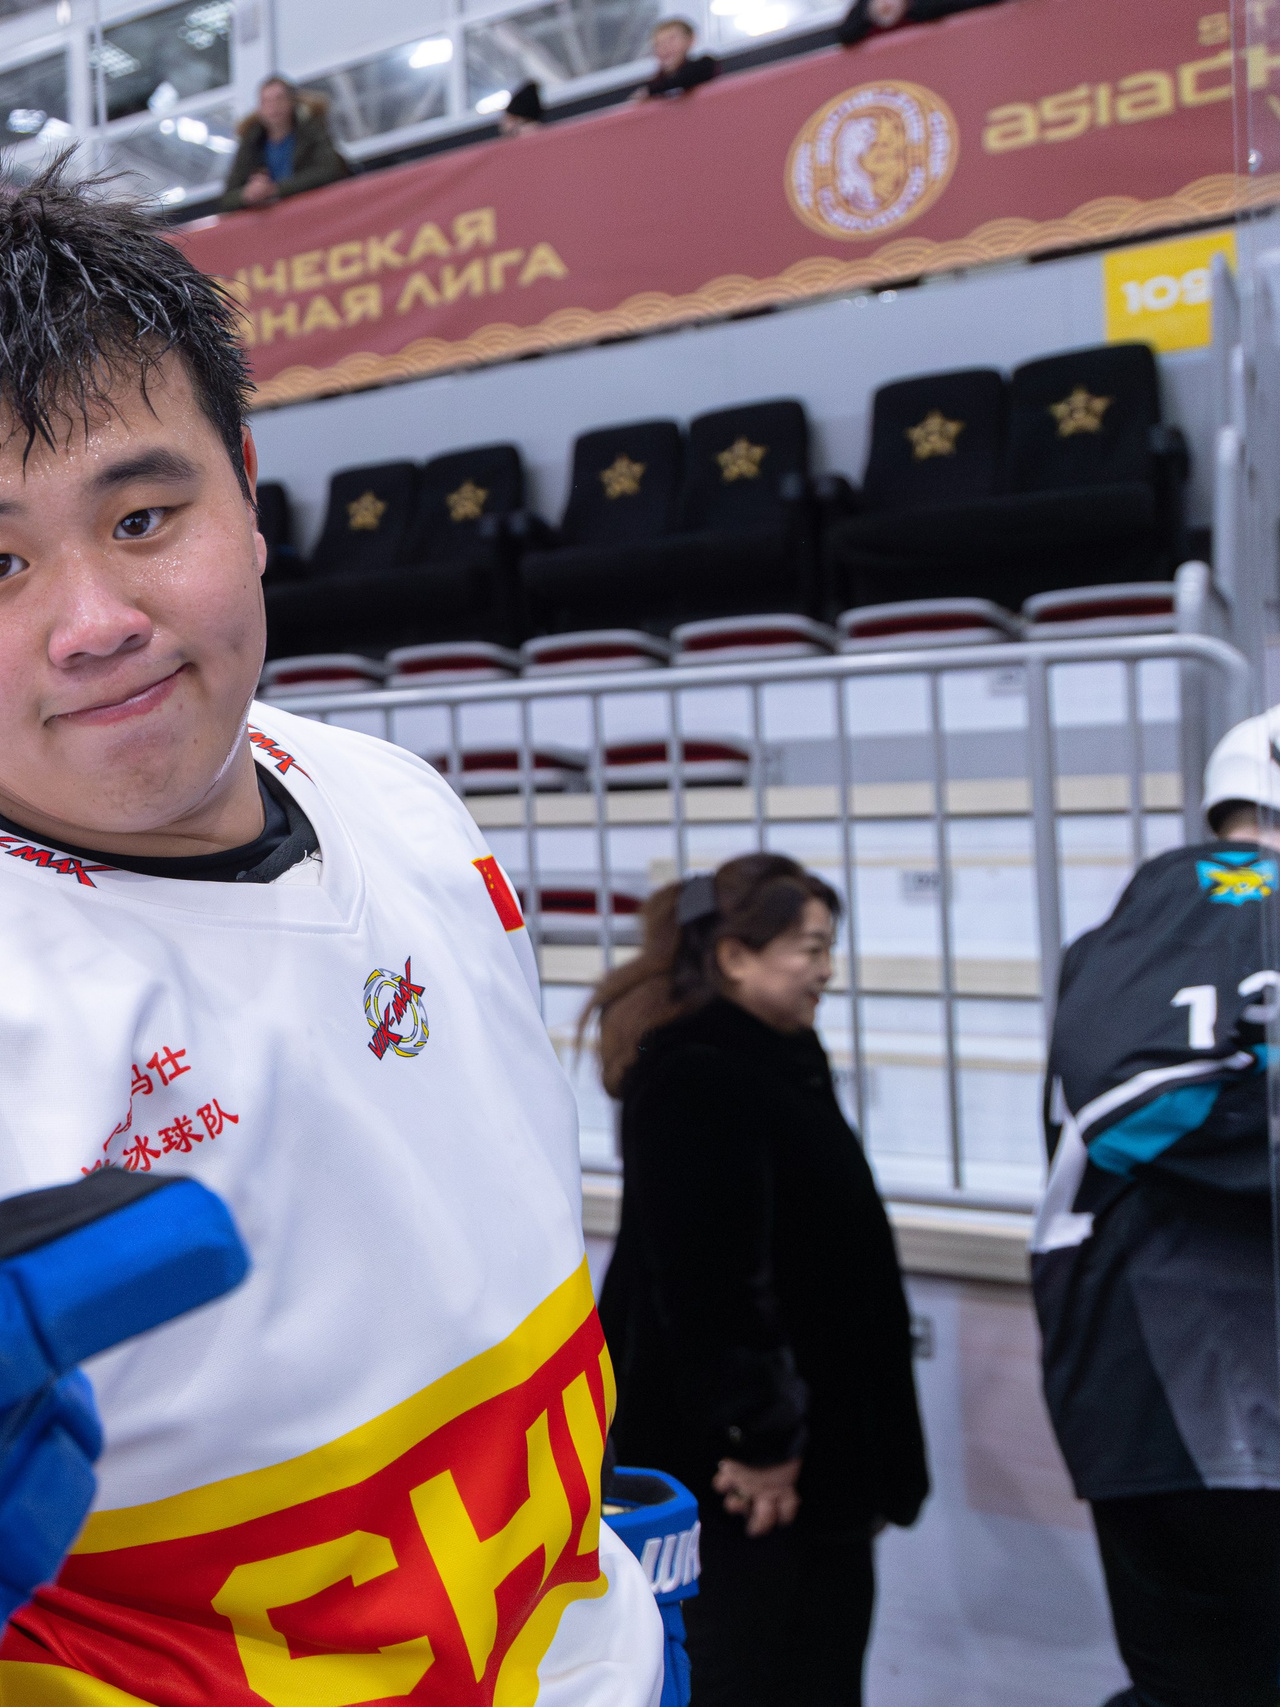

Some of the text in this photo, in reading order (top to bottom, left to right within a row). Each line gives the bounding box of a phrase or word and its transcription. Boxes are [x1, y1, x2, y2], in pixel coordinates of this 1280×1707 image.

[396, 241, 568, 316] ЛИГА
[1122, 268, 1213, 315] 109
[368, 955, 426, 1061] VIK-MAX
[81, 1098, 239, 1176] 冰球队
[210, 1339, 617, 1707] CHI
